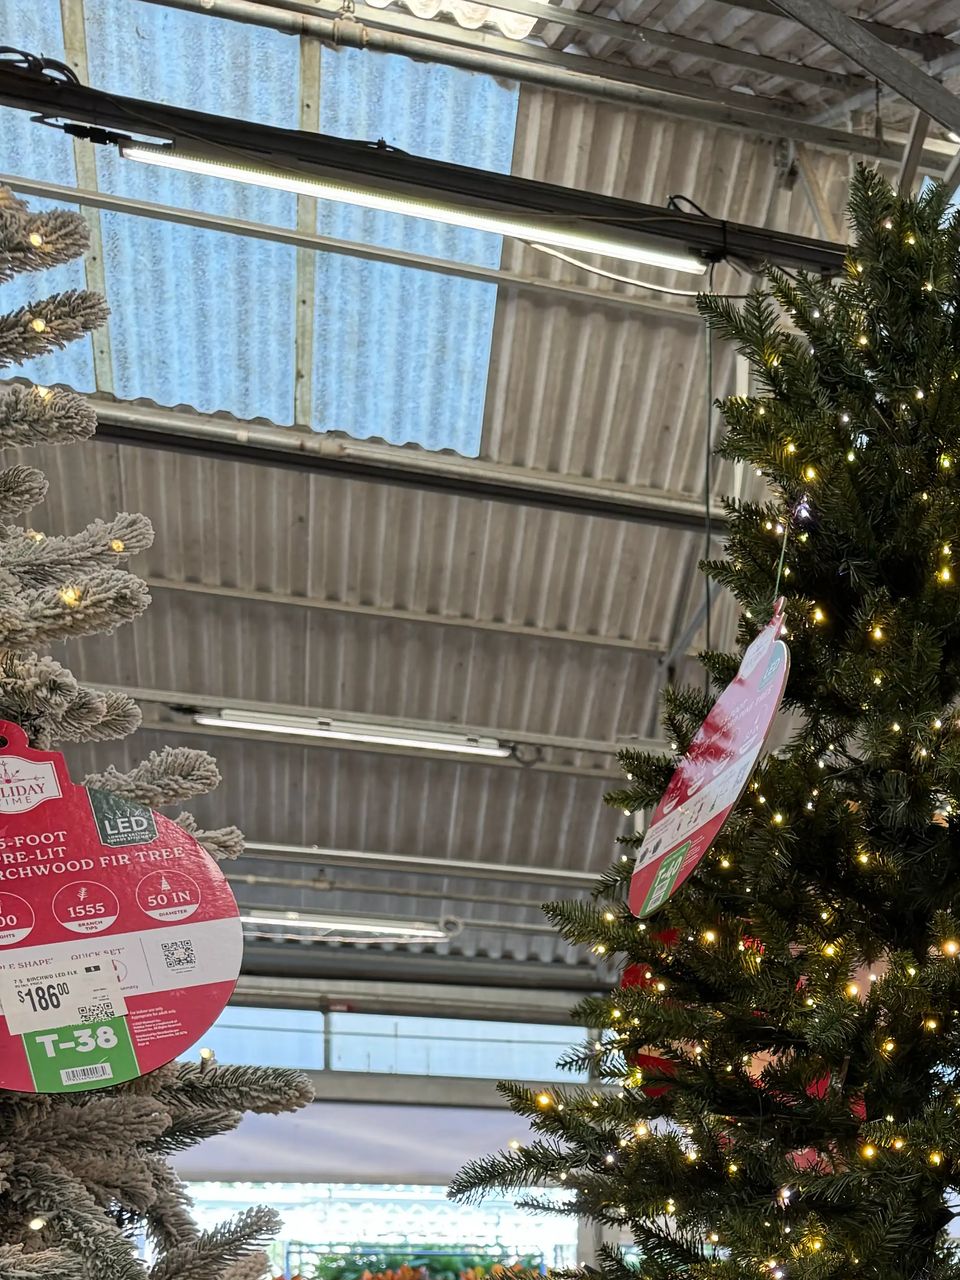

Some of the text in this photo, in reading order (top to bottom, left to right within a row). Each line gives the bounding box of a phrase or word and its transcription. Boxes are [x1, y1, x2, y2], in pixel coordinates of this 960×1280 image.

[104, 816, 148, 834] LED
[99, 854, 131, 867] FIR
[134, 847, 186, 862] TREE
[147, 890, 191, 907] 50 IN
[67, 902, 105, 918] 1555
[158, 909, 187, 917] DIAMETER
[78, 920, 103, 928] BRANCH
[35, 1026, 118, 1058] T-38
